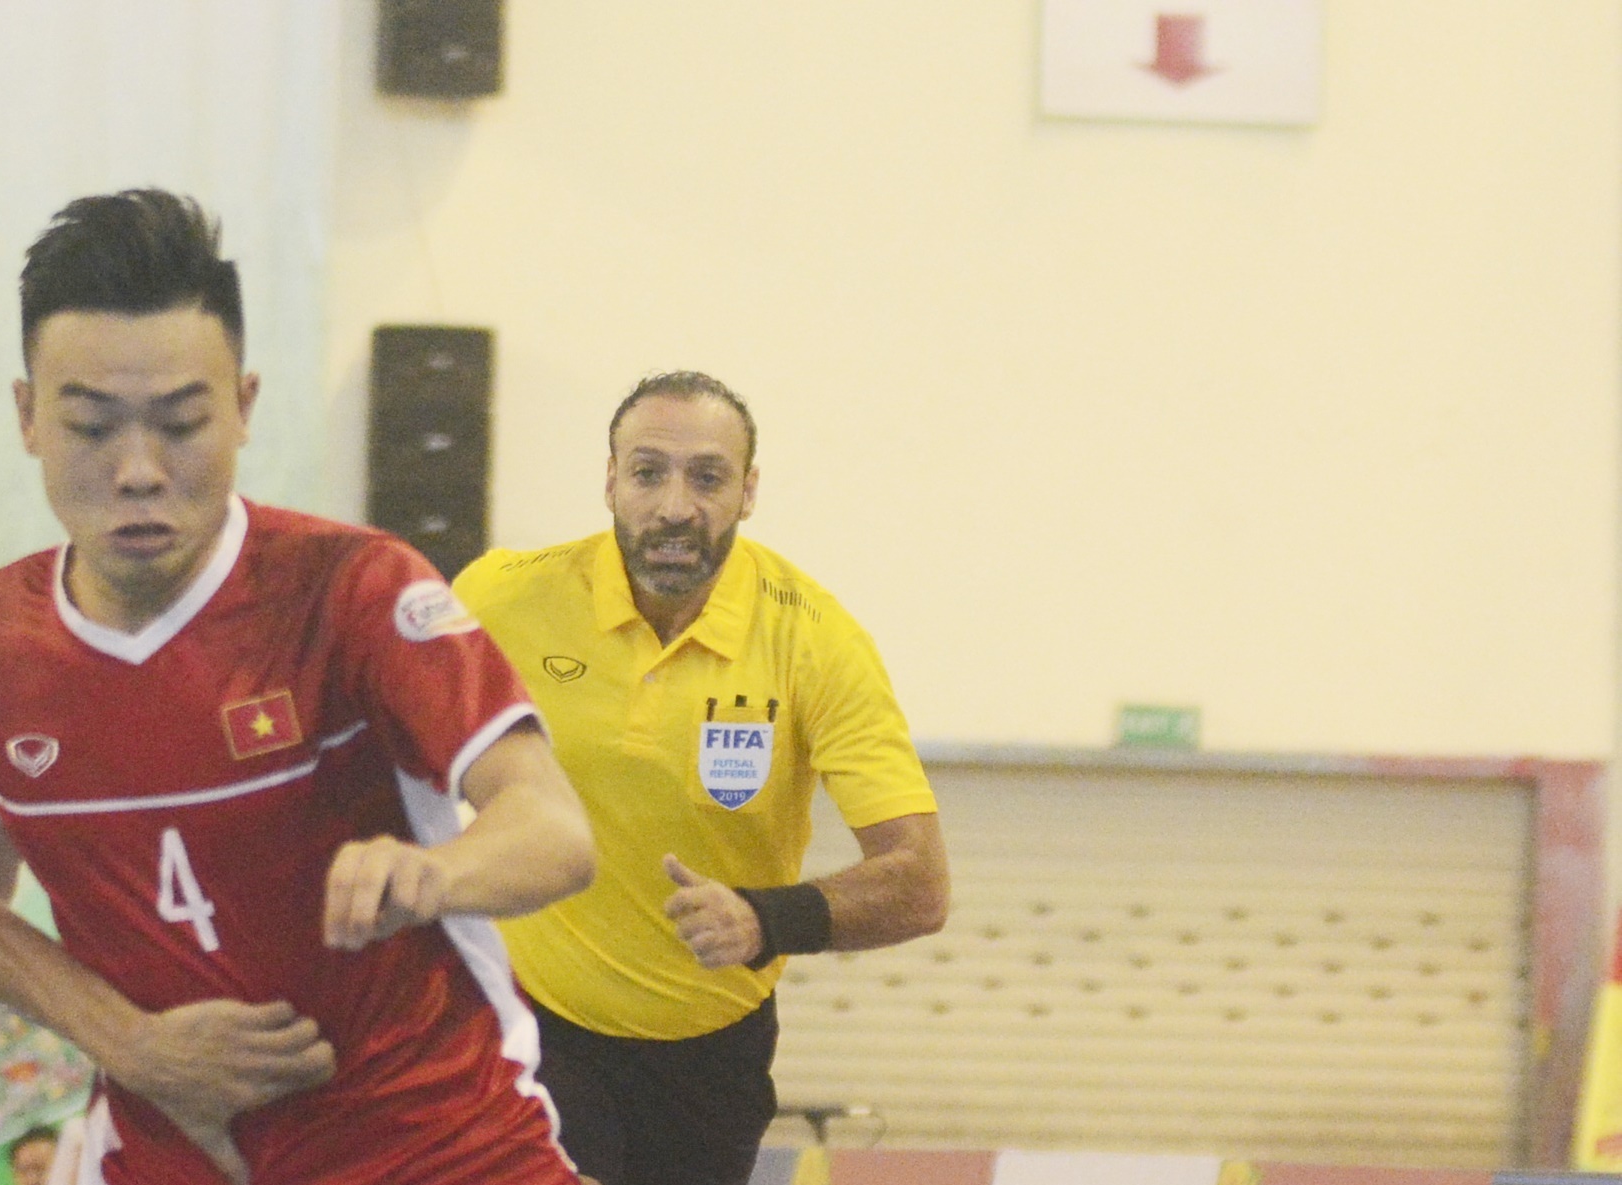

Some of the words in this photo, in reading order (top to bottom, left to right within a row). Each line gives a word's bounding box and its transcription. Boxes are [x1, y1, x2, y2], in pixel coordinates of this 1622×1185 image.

[706, 728, 765, 749] FIFA
[713, 759, 755, 768] FUTSAL
[709, 769, 759, 779] REFEREE
[719, 791, 747, 802] 2019
[157, 827, 220, 952] 4
